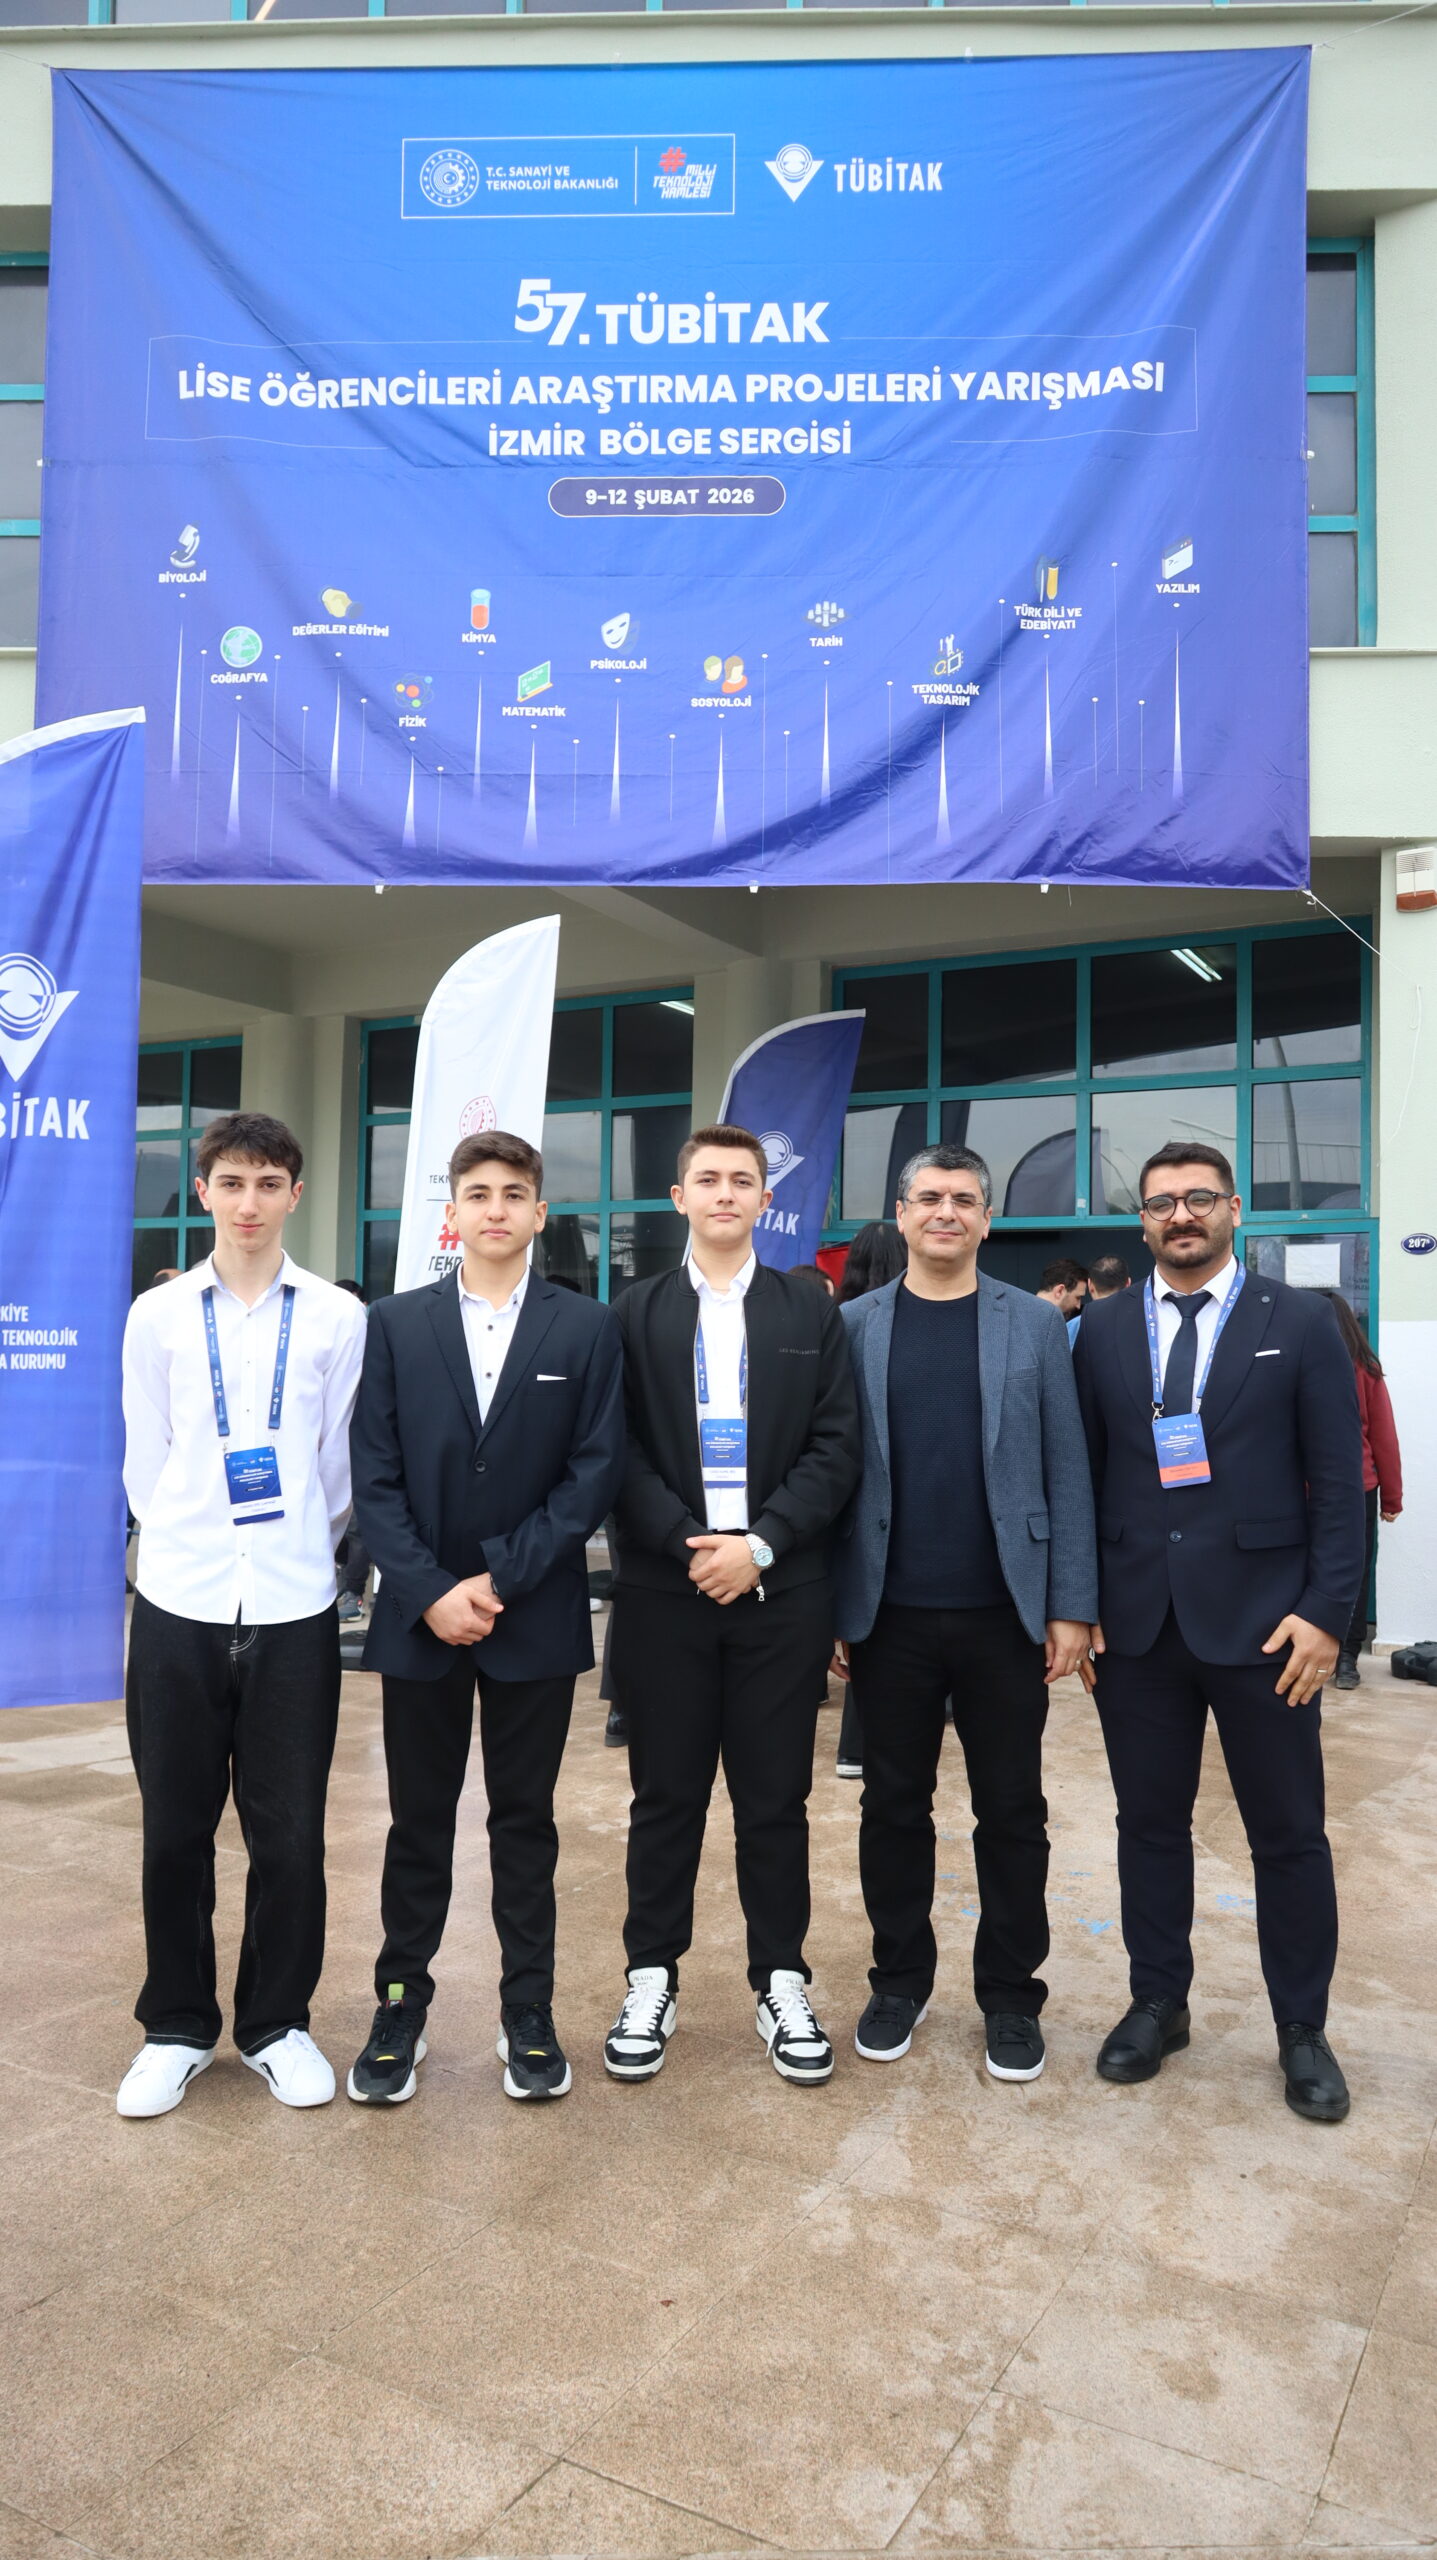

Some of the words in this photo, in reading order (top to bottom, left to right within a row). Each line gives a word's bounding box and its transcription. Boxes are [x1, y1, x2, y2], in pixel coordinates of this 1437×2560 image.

[486, 167, 506, 177] T.C.
[509, 165, 551, 176] SANAYİ
[555, 166, 569, 176] VE
[834, 157, 943, 193] TÜBİTAK
[486, 177, 551, 191] TEKNOLOJİ
[554, 176, 619, 190] BAKANLIĞI
[515, 279, 589, 345] 57.
[596, 292, 829, 344] TÜBİTAK
[179, 363, 251, 402] LİSE
[259, 369, 501, 408] ÖĞRENCİLERİ
[510, 375, 737, 413] ARAŞTIRMA
[746, 366, 941, 402] PROJELERİ
[950, 361, 1164, 410] YARIŞMASI
[489, 422, 585, 455] İZMİR
[600, 422, 711, 455] BÖLGE
[720, 420, 851, 454] SERGİSİ
[586, 489, 627, 504] 9-12
[635, 489, 699, 509] ŞUBAT
[708, 488, 754, 503] 2026
[159, 570, 206, 583] BİYOLOJİ
[1156, 584, 1200, 593] YAZILIM
[1014, 604, 1041, 618] TÜRK
[1044, 606, 1064, 618] DİLİ
[1067, 608, 1082, 617] VE
[293, 623, 347, 635] DEĞERLER
[349, 624, 389, 636] EĞİTİMİ
[1020, 618, 1076, 630] EDEBİYATI
[462, 631, 496, 643] KİMYA
[809, 635, 843, 647] TARİH
[591, 658, 646, 669] PSİKOLOJİ
[211, 672, 268, 683] COĞRAFYA
[912, 683, 979, 696] TEKNOLOJİK
[691, 694, 752, 708] SOSYOLOJİ
[921, 695, 970, 706] TASARIM
[502, 705, 566, 716] MATEMATİK
[399, 715, 426, 727] FİZİK
[0, 1304, 28, 1322] KİYE
[2, 1327, 77, 1345] TEKNOLOJİK
[11, 1354, 65, 1369] KURUMU
